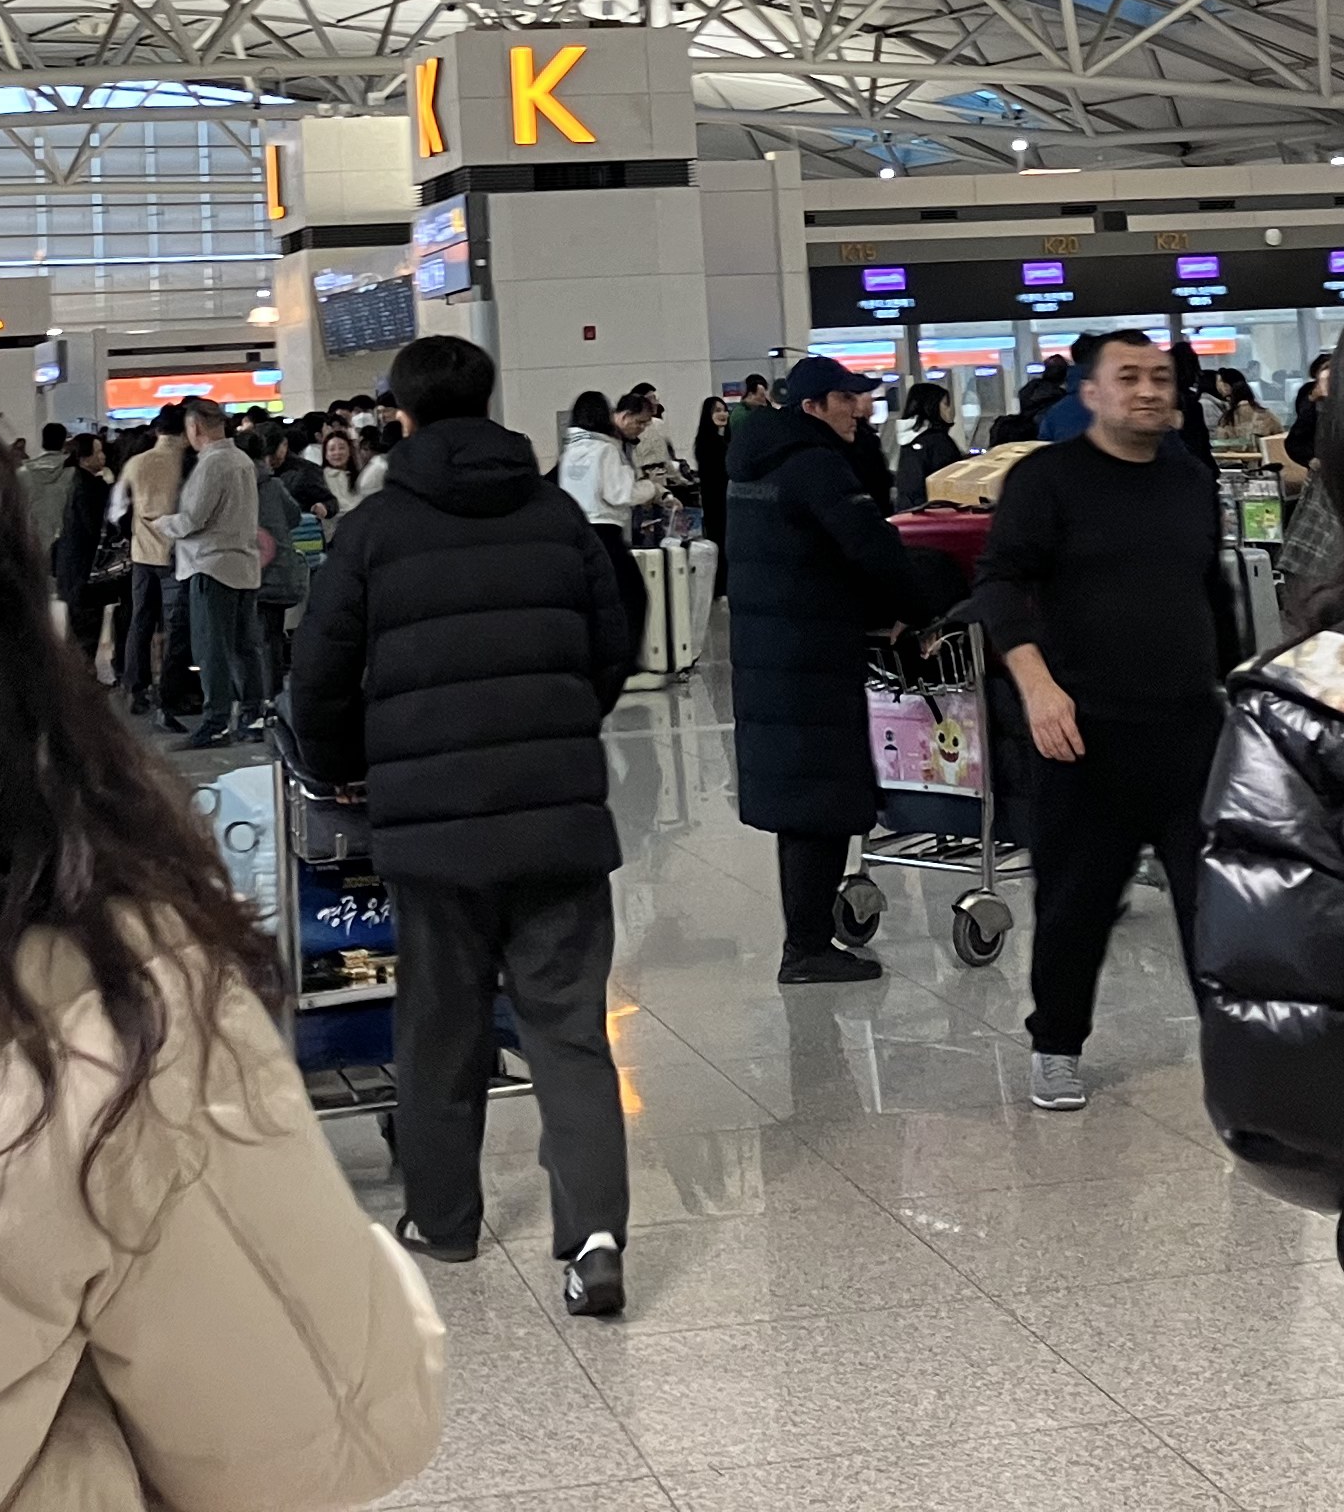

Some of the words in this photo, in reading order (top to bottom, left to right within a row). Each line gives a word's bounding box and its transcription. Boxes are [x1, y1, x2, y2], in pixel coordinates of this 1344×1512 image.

[415, 57, 443, 158] K
[510, 45, 596, 145] K
[1043, 236, 1080, 256] K20
